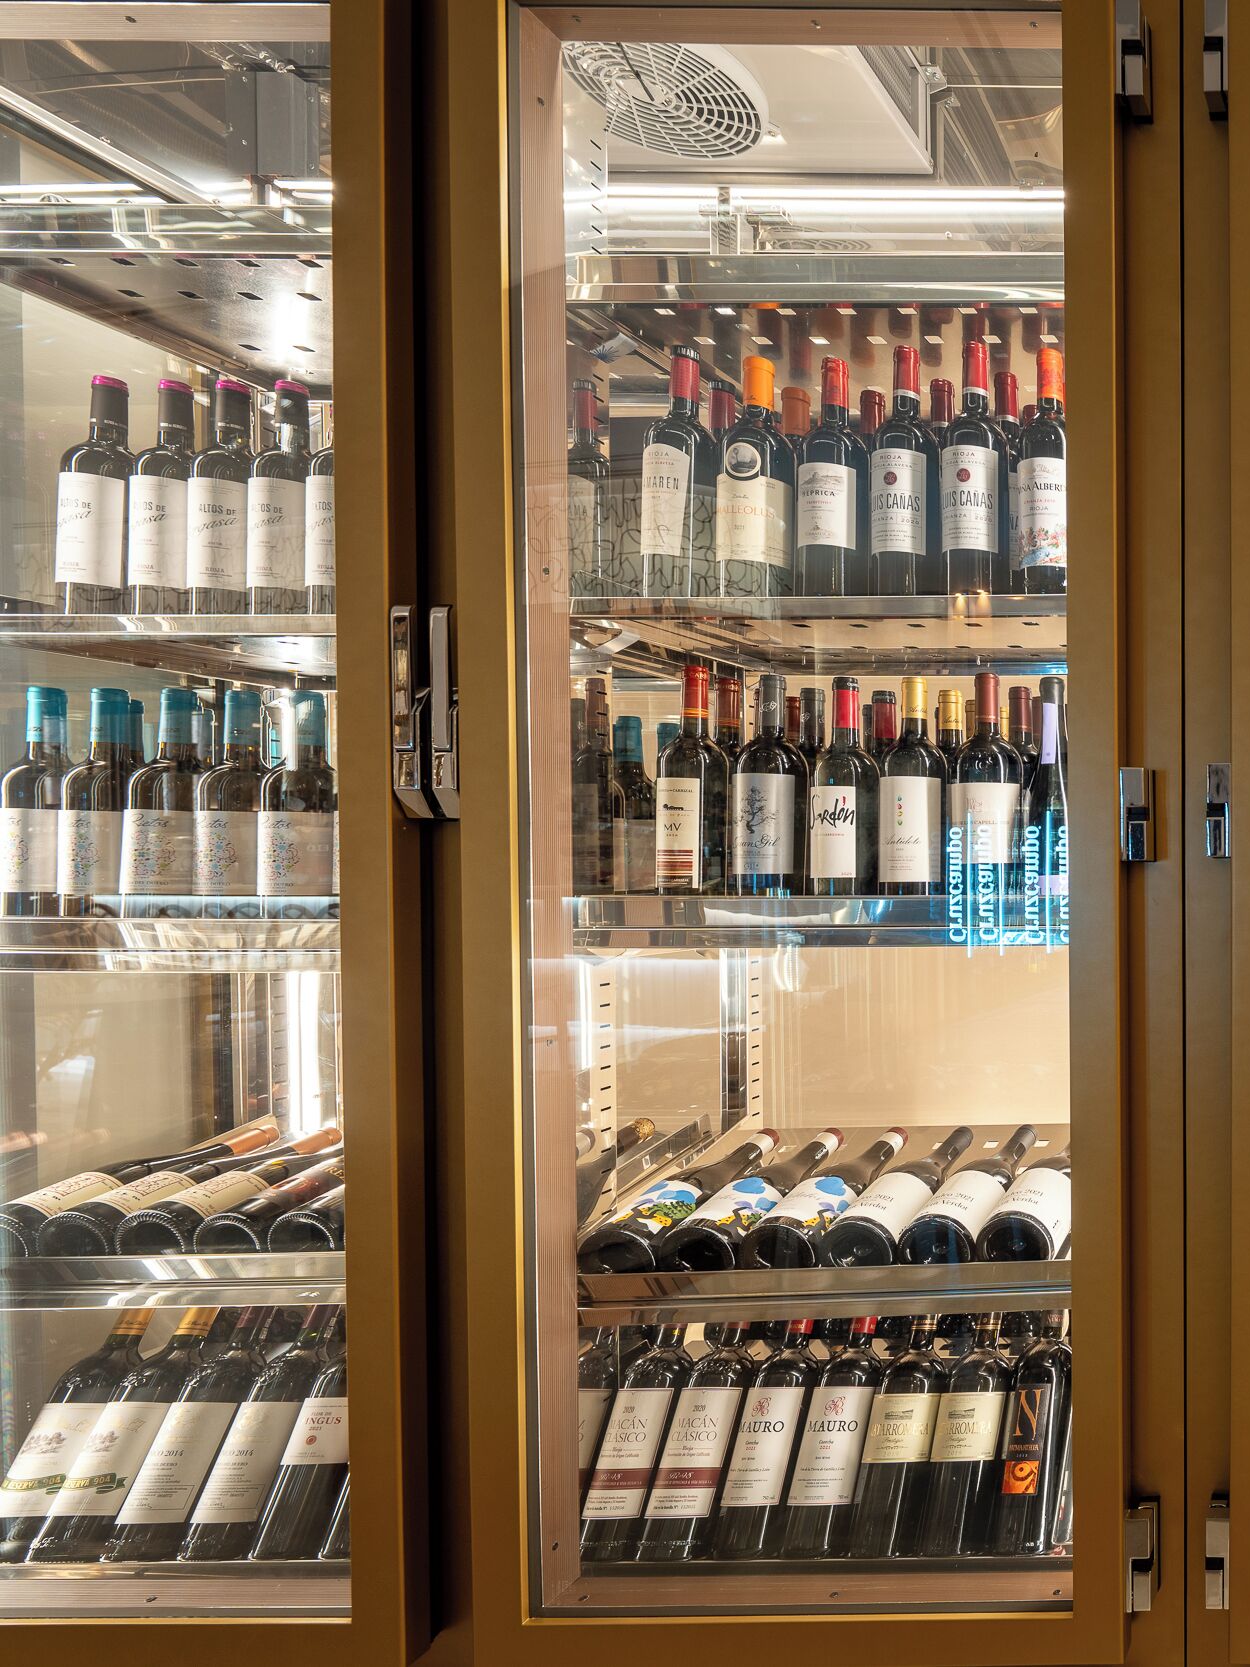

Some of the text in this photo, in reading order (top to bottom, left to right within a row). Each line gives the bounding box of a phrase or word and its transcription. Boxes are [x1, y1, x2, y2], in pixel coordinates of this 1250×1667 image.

[1031, 481, 1063, 492] ALBER
[872, 492, 920, 513] LUIS CAÑAS
[942, 490, 993, 510] LUIS CAÑAS
[81, 502, 92, 510] DE
[156, 504, 166, 512] DE
[252, 503, 284, 514] LTOS DE
[858, 1200, 887, 1211] Verdot
[941, 1200, 969, 1211] Verdot
[1011, 1196, 1039, 1206] Verdot
[622, 1405, 635, 1414] 2020
[692, 1404, 706, 1413] 2020
[1012, 1388, 1045, 1441] N
[305, 1416, 343, 1426] INGUS
[609, 1415, 648, 1430] MACÁN
[678, 1414, 719, 1429] MACÁN
[738, 1420, 785, 1433] MAURO
[807, 1420, 859, 1433] MAURO
[604, 1428, 647, 1443] CLÁSICO
[671, 1427, 718, 1442] CLÁSICO
[164, 1449, 184, 1458] 2014
[235, 1449, 255, 1457] 2014
[7, 1476, 62, 1490] RESERVA 904
[94, 1476, 111, 1486] 904
